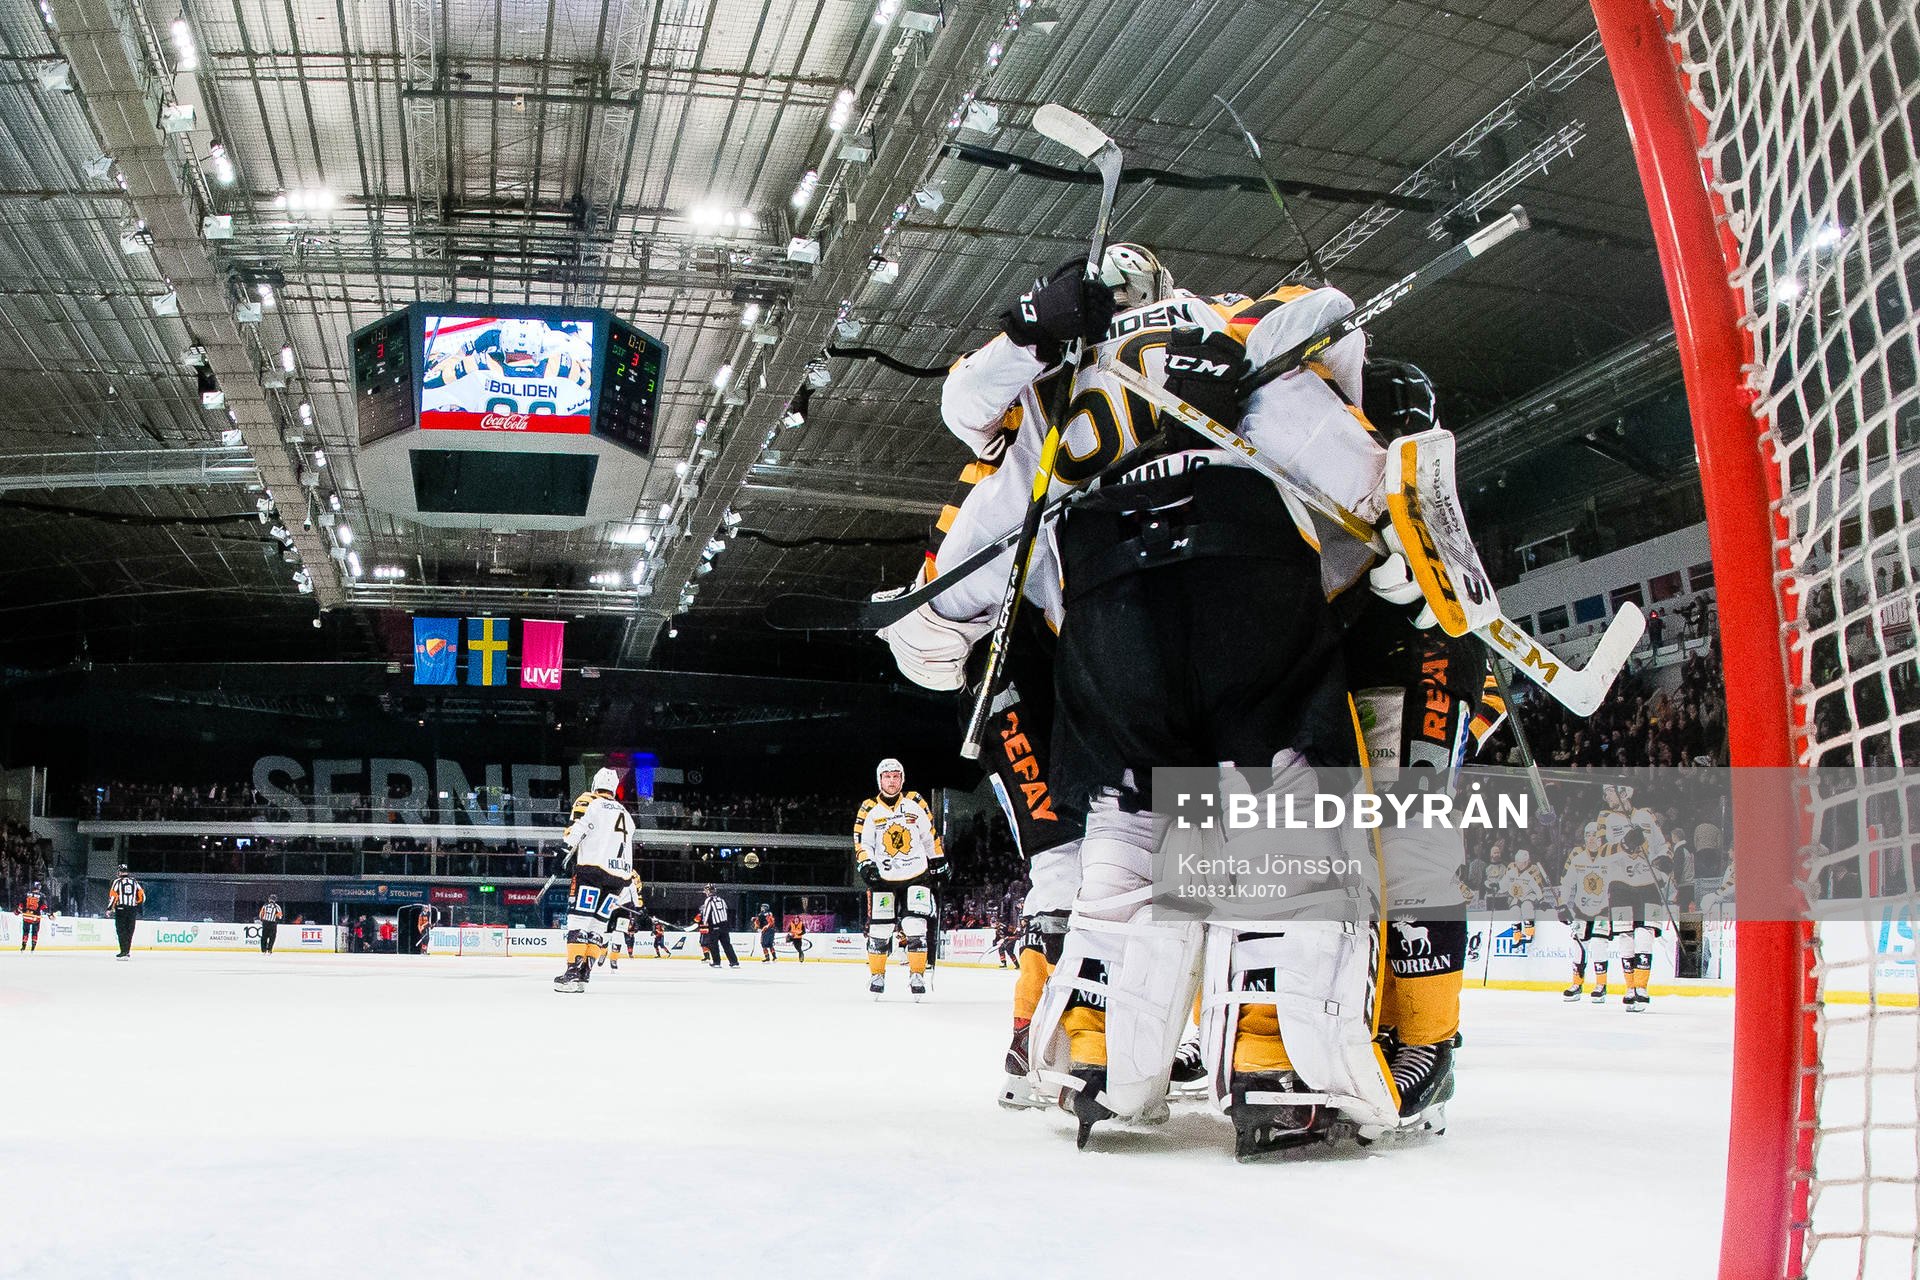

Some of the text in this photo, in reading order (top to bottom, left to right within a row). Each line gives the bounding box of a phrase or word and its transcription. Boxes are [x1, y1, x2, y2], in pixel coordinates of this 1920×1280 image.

[630, 352, 640, 367] 3
[1163, 353, 1231, 378] CCM
[616, 362, 626, 377] 2
[489, 379, 558, 399] BOLIDEN
[647, 378, 655, 393] 3
[1177, 402, 1258, 457] CCM
[252, 754, 684, 843] SERNEE
[1393, 898, 1427, 906] CCM
[156, 929, 194, 944] Lendo
